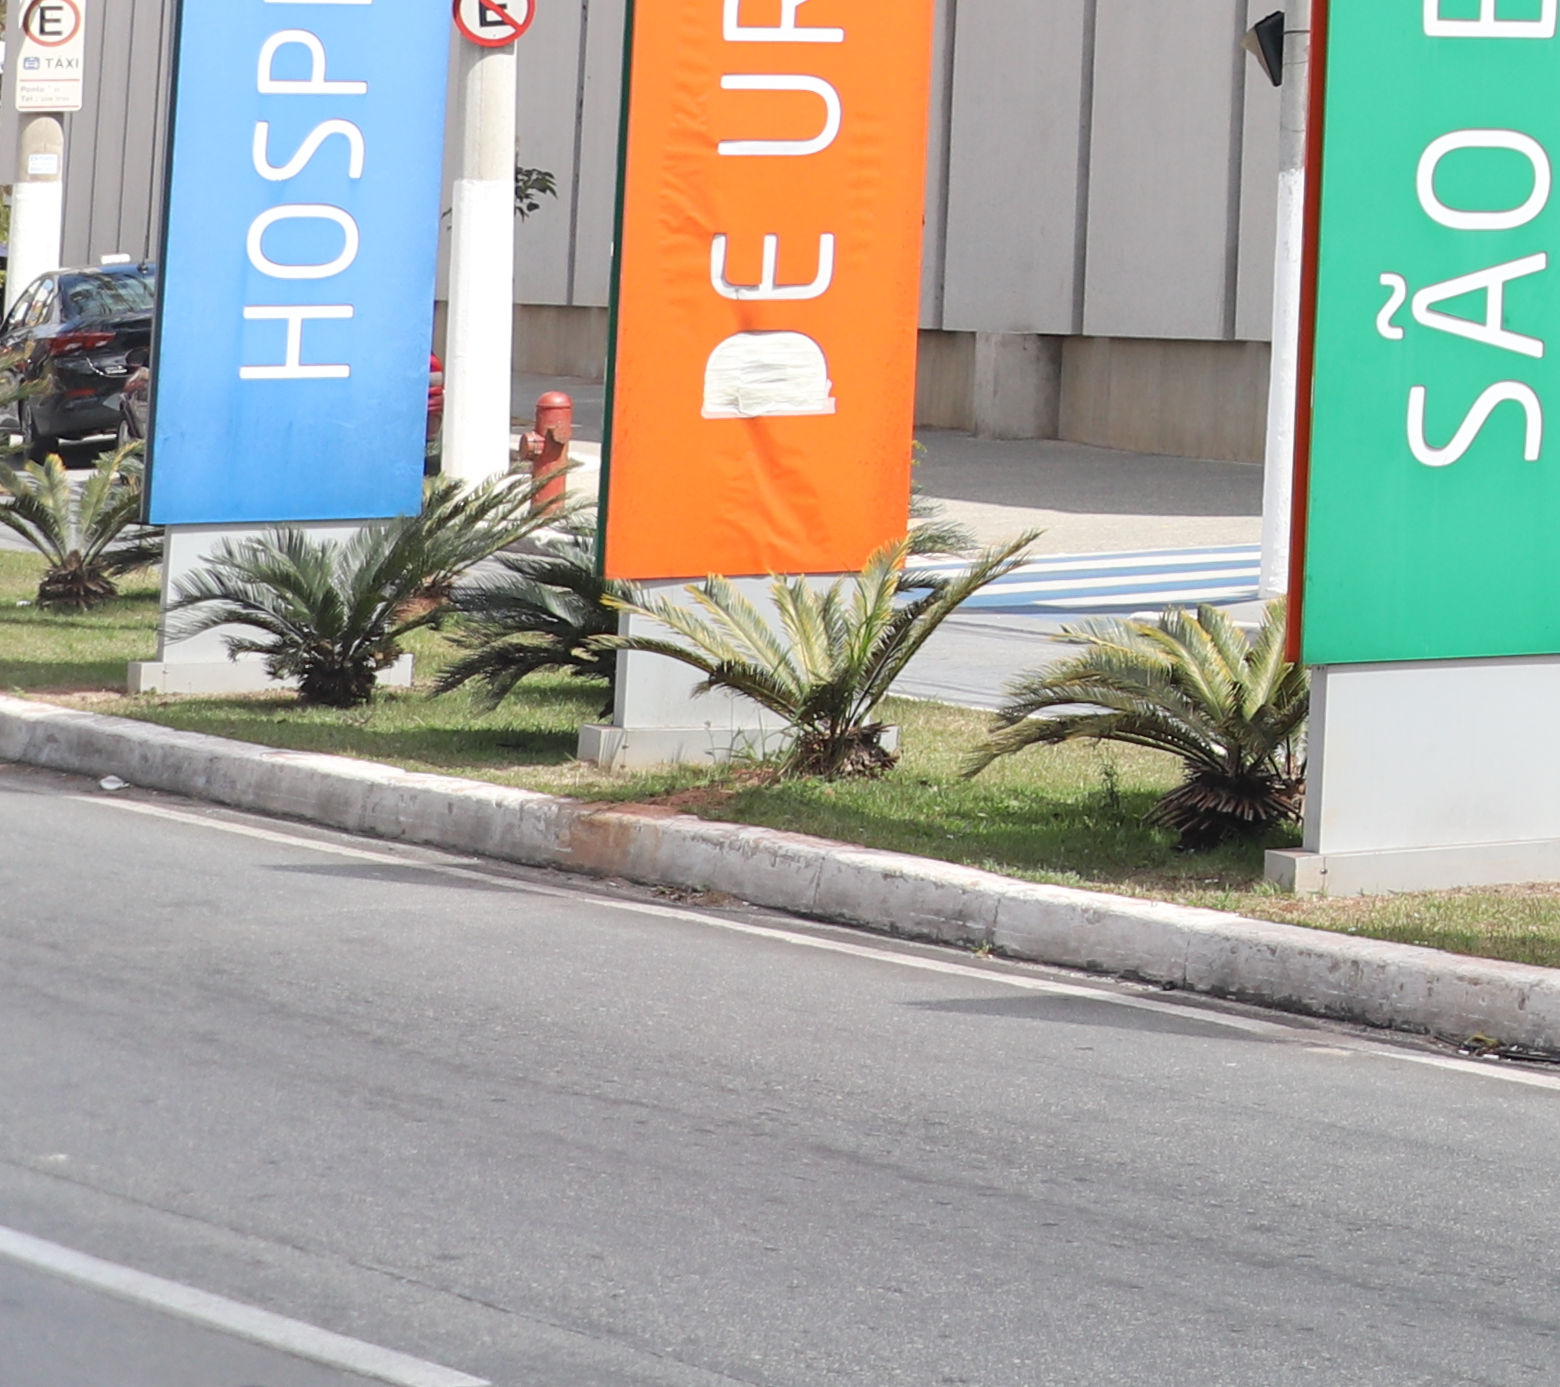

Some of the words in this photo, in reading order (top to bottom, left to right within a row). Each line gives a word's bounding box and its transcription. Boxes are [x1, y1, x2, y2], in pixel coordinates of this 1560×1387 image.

[39, 5, 64, 36] E
[45, 55, 79, 69] TÁXI
[700, 231, 837, 420] DE
[1376, 127, 1552, 469] SÃO
